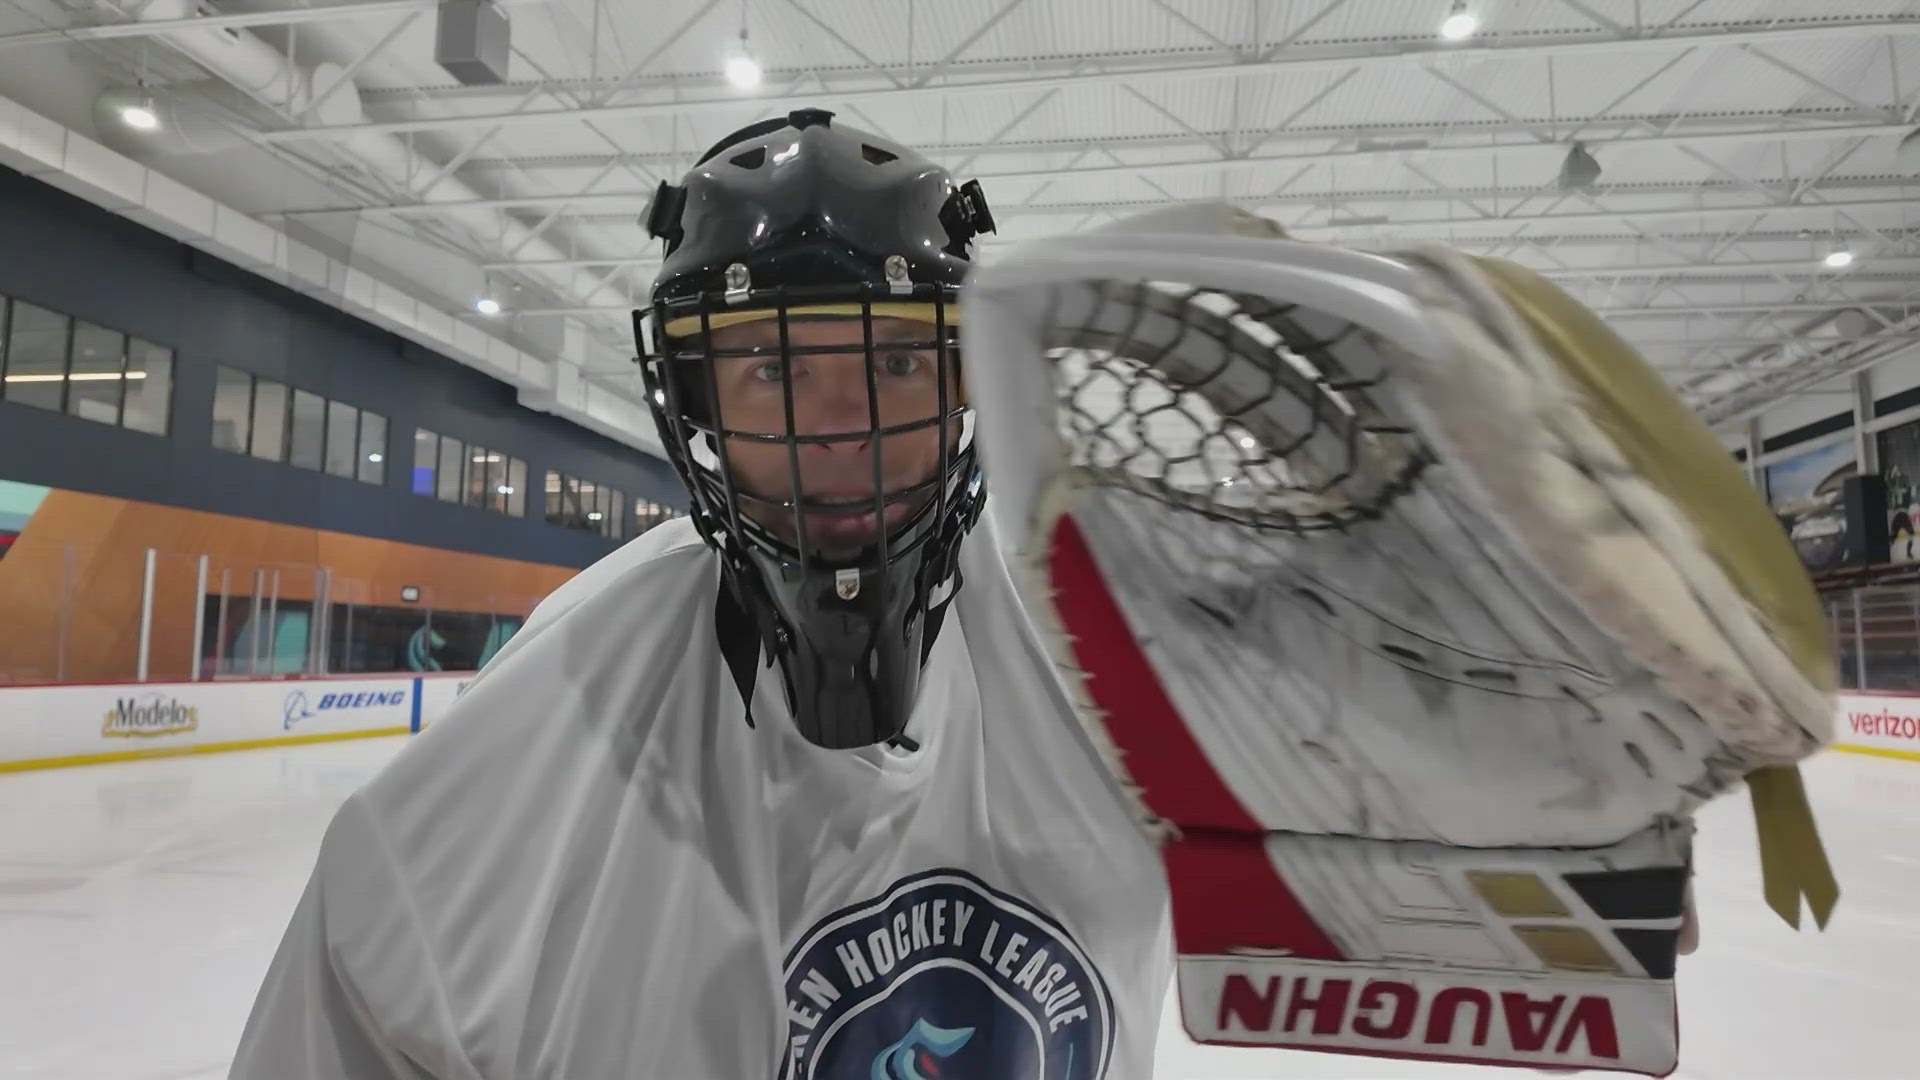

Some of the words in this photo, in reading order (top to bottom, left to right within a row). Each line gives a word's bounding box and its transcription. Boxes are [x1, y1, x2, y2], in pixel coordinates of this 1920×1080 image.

[115, 697, 187, 727] Modelo
[318, 691, 405, 711] BOEING
[835, 899, 975, 988] HOCKEY
[979, 920, 1088, 1033] LEAGUE
[1218, 973, 1620, 1060] VAUGHN
